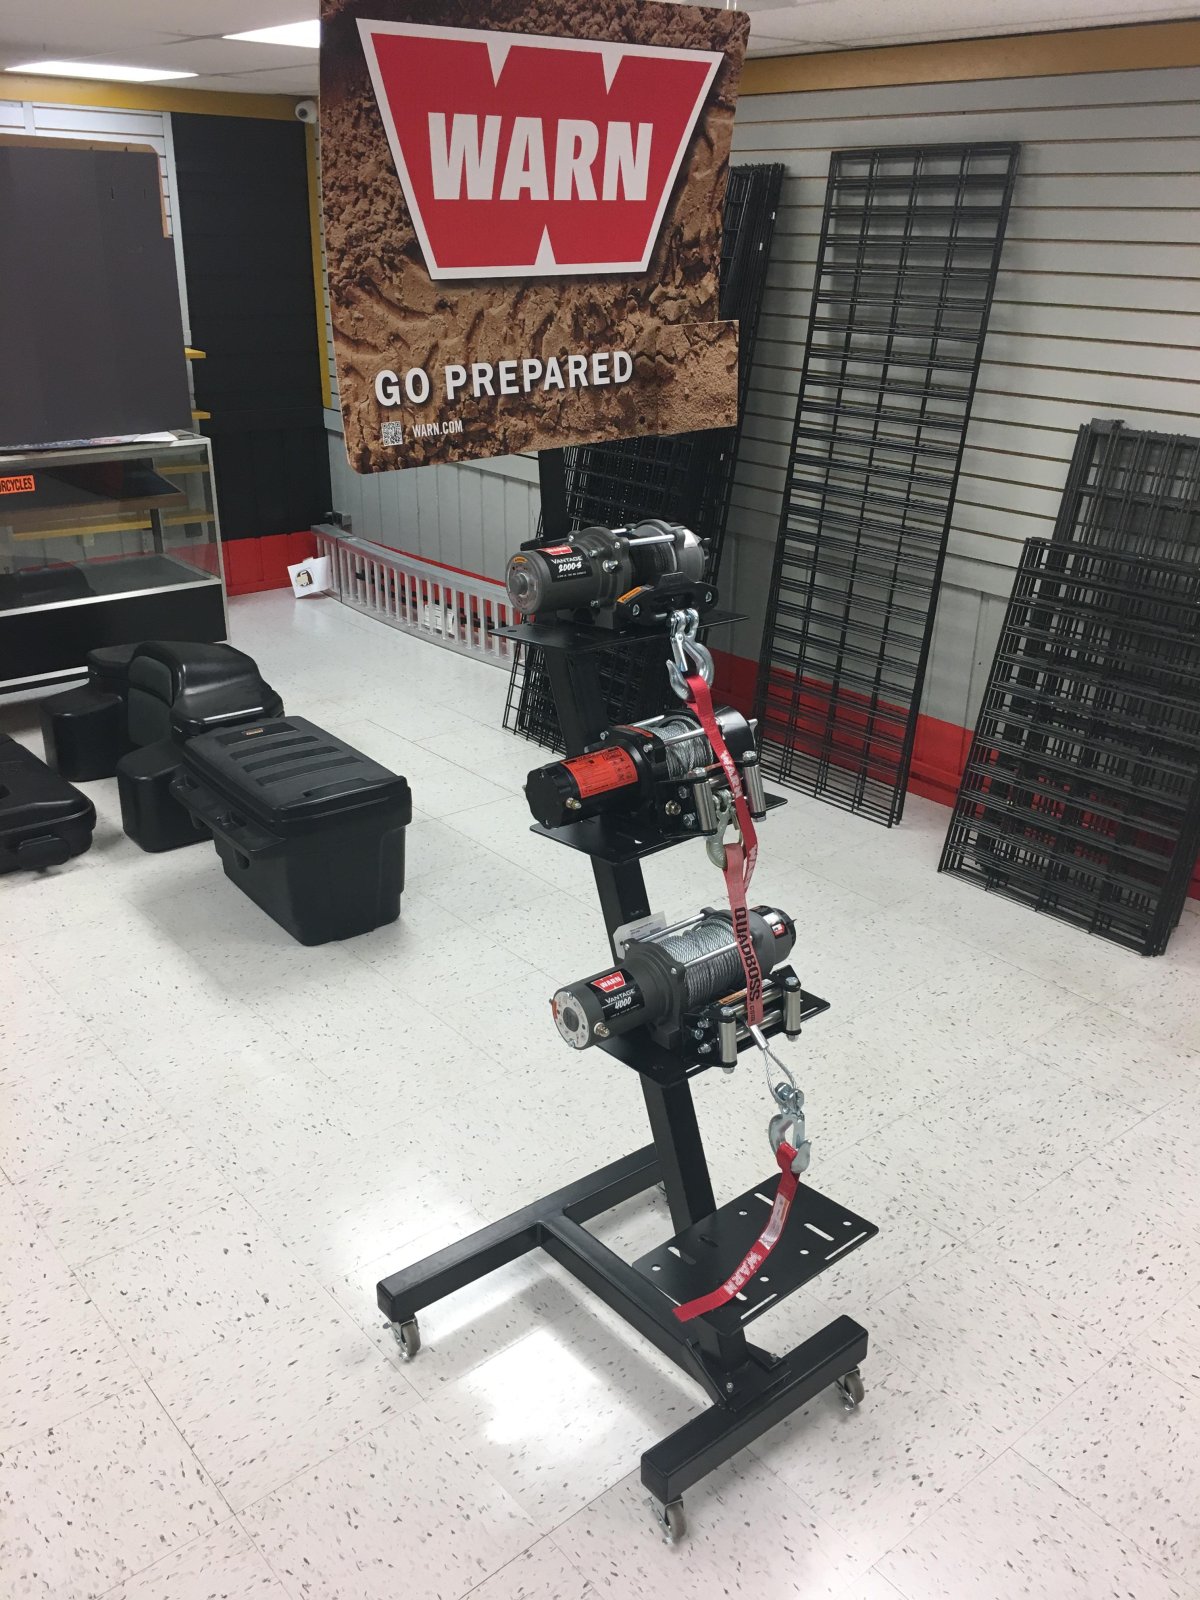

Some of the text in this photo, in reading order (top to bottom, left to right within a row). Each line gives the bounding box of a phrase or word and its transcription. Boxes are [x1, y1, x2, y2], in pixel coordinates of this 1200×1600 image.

[427, 112, 654, 201] WARN
[374, 351, 633, 406] GO PREPARED
[411, 420, 464, 438] WARN.COM
[0, 477, 33, 493] RCYCLES
[551, 555, 583, 565] VANTAGE
[600, 976, 622, 988] WARN
[604, 986, 636, 1004] VANTAGE
[614, 996, 632, 1010] 4000
[723, 1251, 763, 1295] WARN
